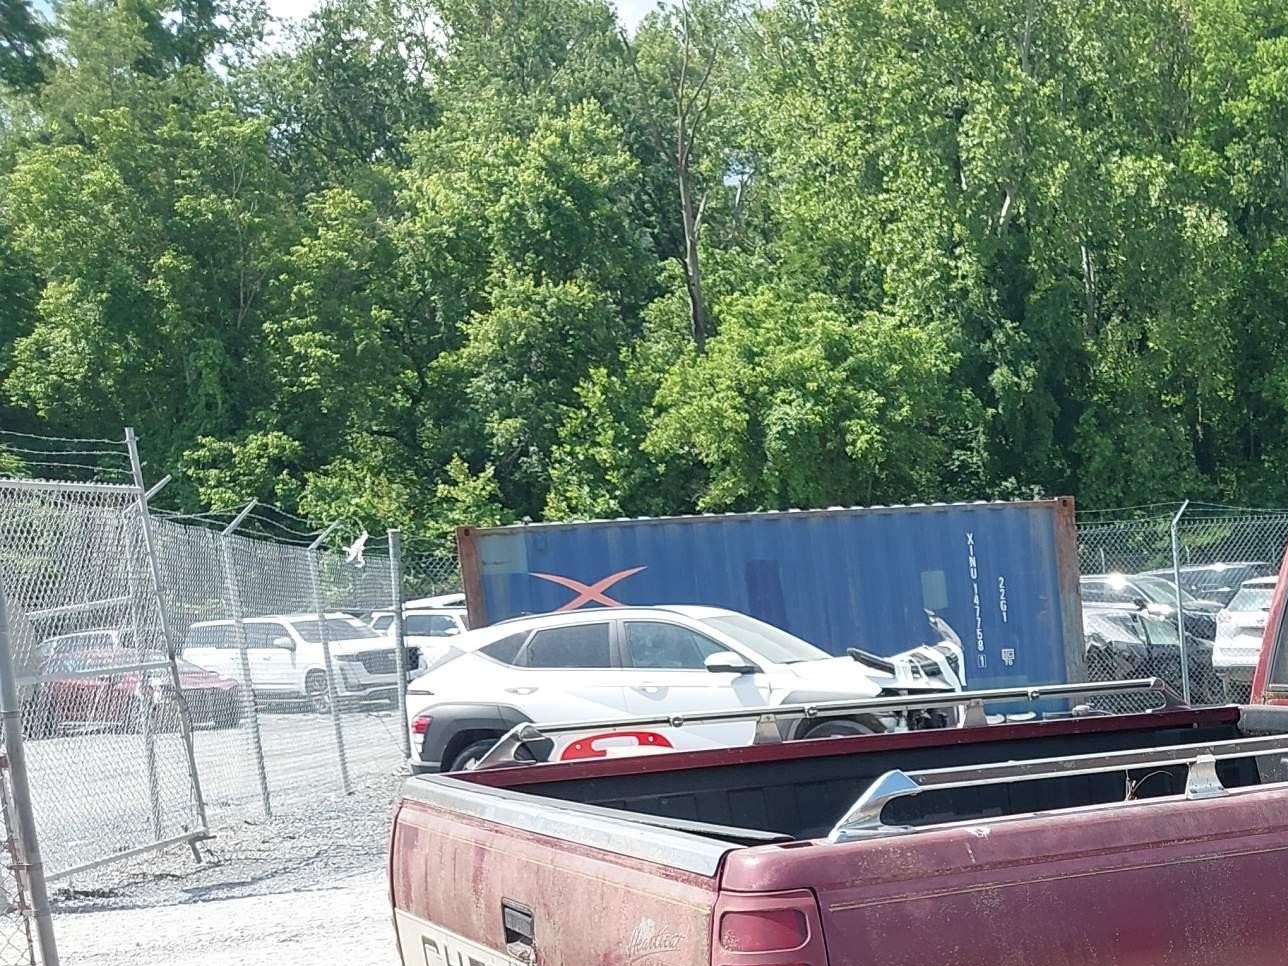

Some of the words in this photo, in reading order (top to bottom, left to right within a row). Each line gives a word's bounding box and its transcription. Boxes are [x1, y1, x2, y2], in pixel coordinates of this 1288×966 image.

[966, 532, 977, 580] XINU
[973, 583, 984, 652] 147758
[997, 576, 1008, 623] 22G1
